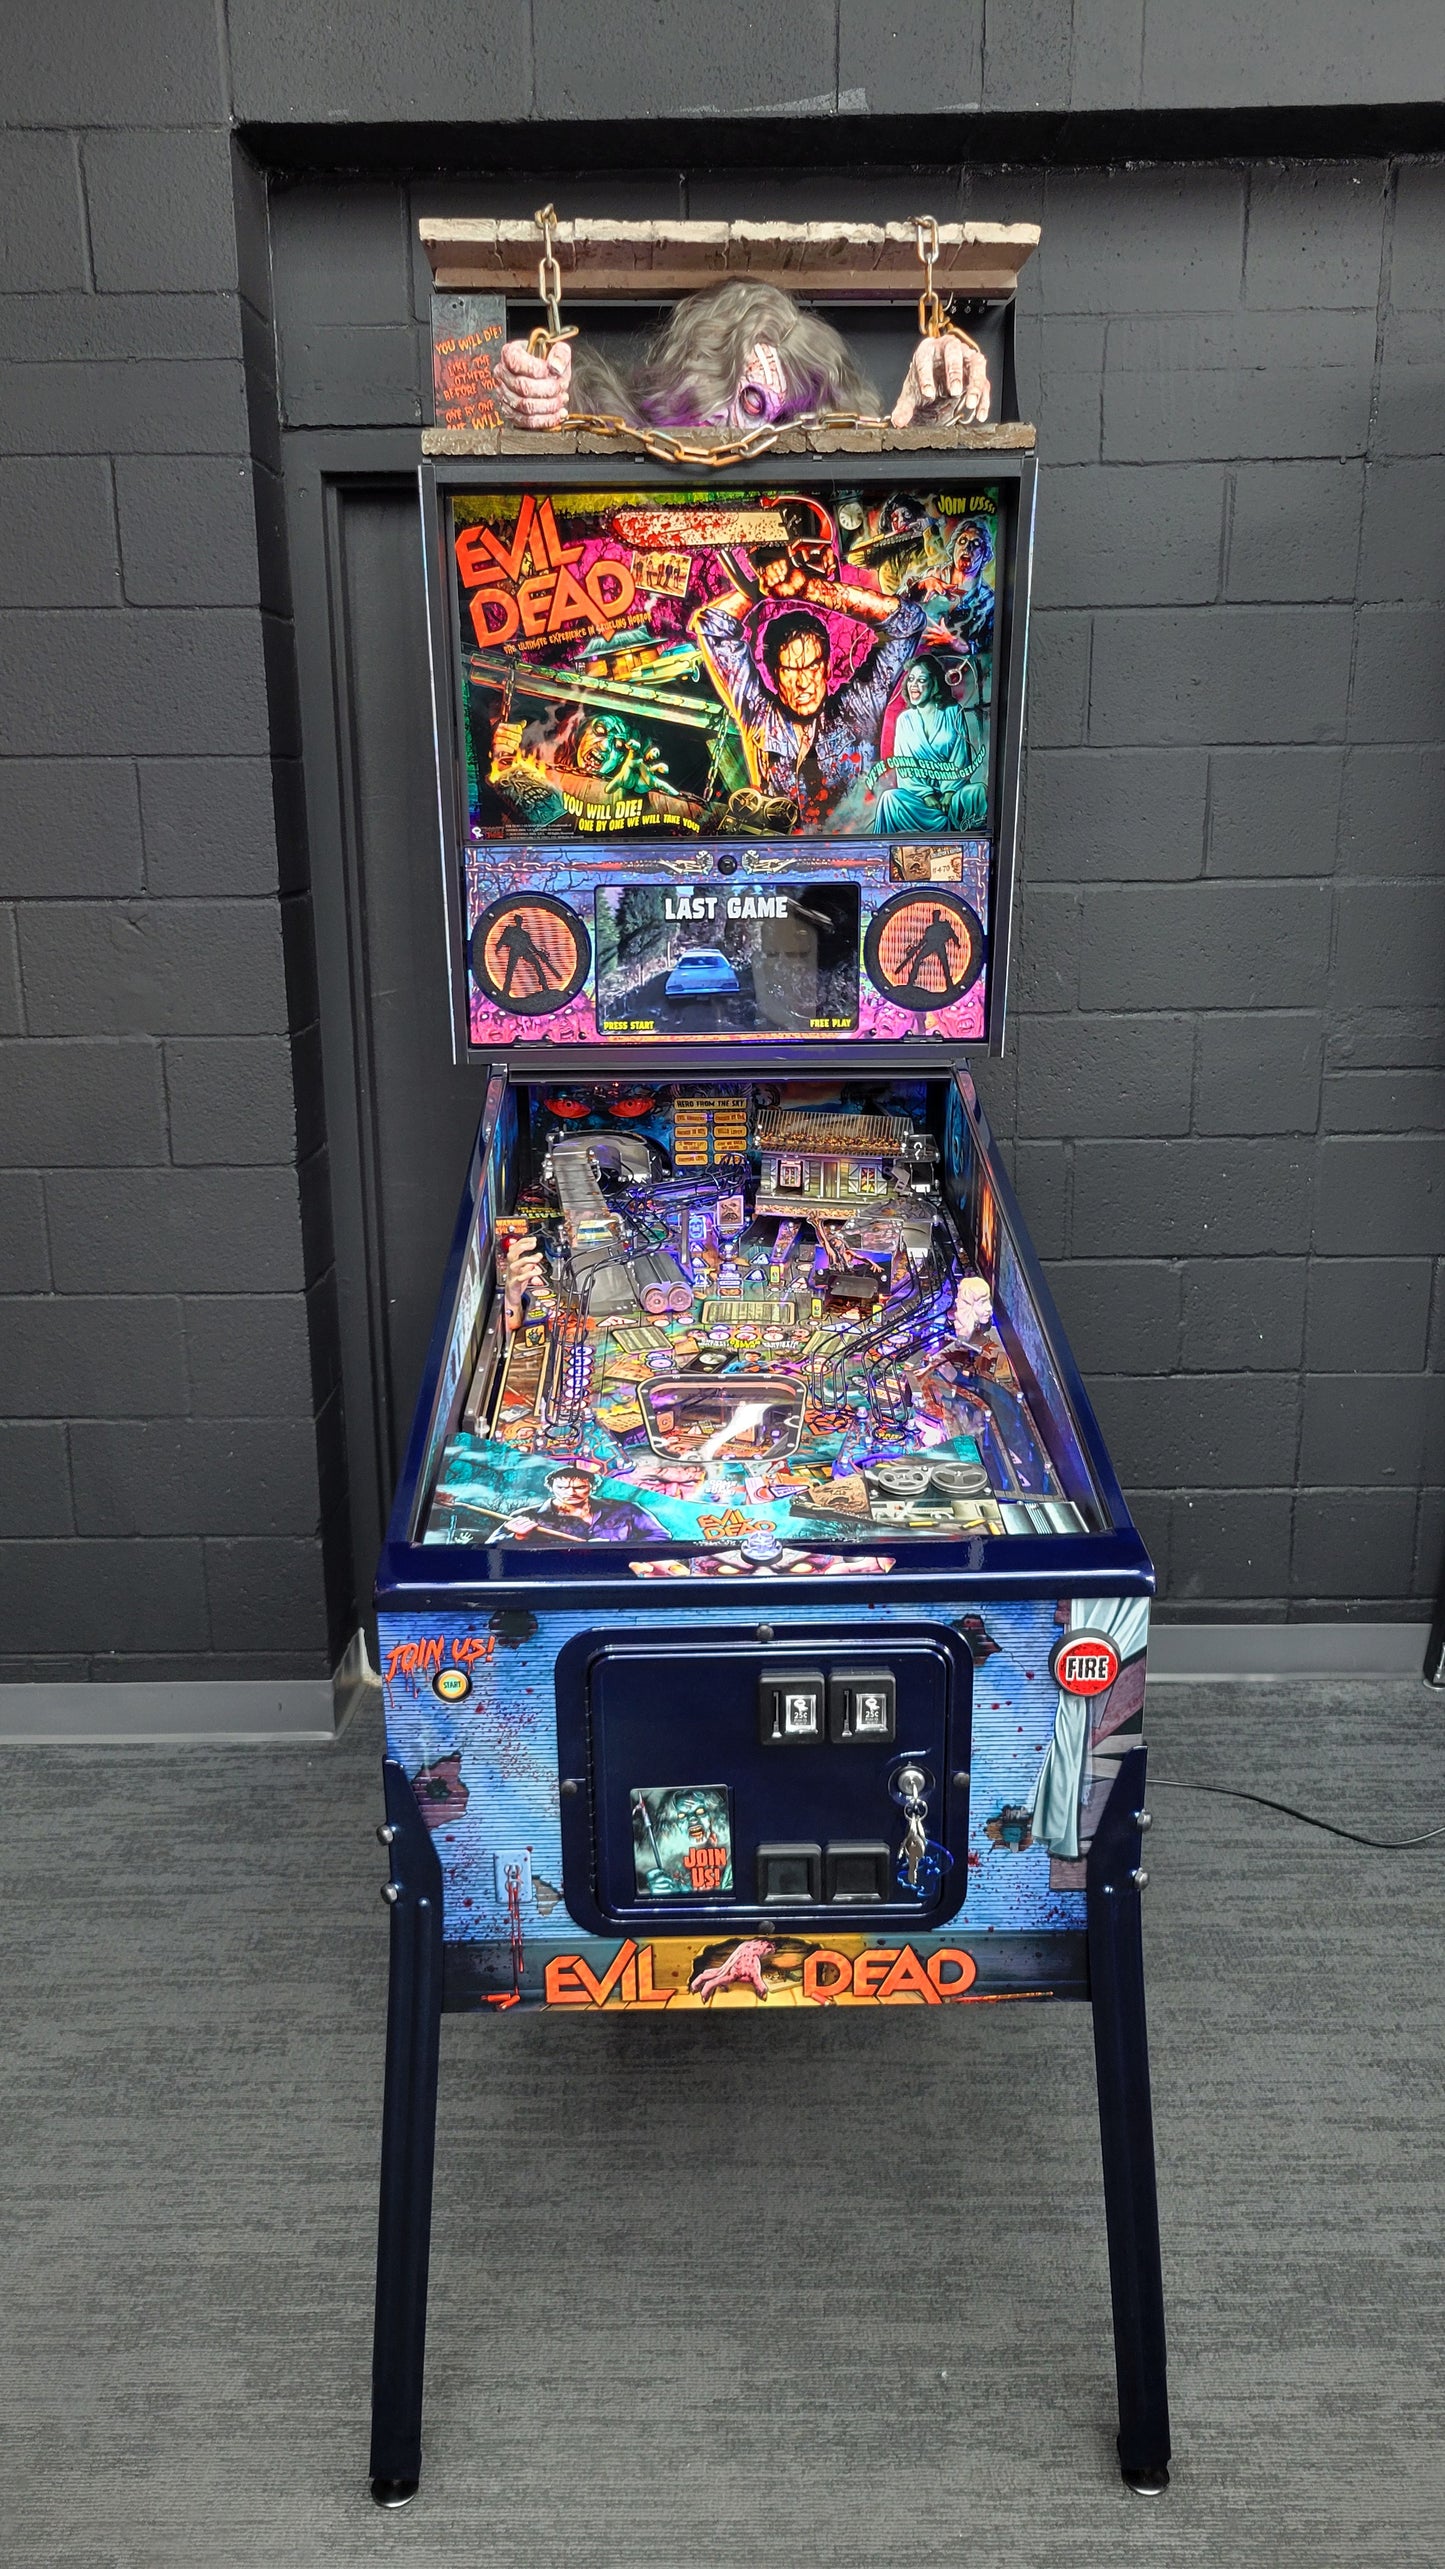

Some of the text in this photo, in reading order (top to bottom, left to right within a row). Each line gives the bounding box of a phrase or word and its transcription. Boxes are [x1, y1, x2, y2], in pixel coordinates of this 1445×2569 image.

[435, 339, 456, 355] YOU
[458, 333, 482, 351] WILL
[447, 354, 490, 377] LIKE THE
[454, 367, 492, 385] OTHERS
[443, 383, 477, 401] BEFORE
[445, 399, 494, 423] ONE BY ONE
[471, 411, 504, 430] WILL
[938, 495, 966, 516] JOIN
[455, 494, 584, 588] EVIL
[469, 561, 636, 649] DEAD
[503, 644, 516, 655] THE
[517, 637, 548, 651] ULTIMATE
[549, 630, 587, 644] EXPERIENCE
[588, 626, 595, 637] IN
[628, 612, 652, 626] HORROR
[887, 757, 917, 769] GONNA
[920, 760, 936, 770] GET
[929, 770, 959, 780] GONNA
[960, 766, 975, 779] GET
[974, 744, 986, 768] YOU
[562, 792, 643, 820] YOU WILL DIE!
[578, 818, 593, 832] ONE
[596, 818, 606, 832] BY
[609, 817, 625, 831] ONE
[627, 816, 640, 828] WE
[642, 813, 660, 826] WILL
[663, 813, 680, 824] TAKE
[682, 817, 700, 833] YOU!
[664, 896, 789, 920] LAST GAME
[603, 1021, 655, 1031] PRESS START
[810, 1019, 851, 1029] FREE PLAY
[697, 1508, 754, 1529] EVIL
[703, 1520, 777, 1541] DEAD
[384, 1634, 496, 1683] JOIN US!
[1066, 1655, 1109, 1680] FIRE
[443, 1680, 461, 1689] START
[684, 1847, 727, 1868] JOIN
[691, 1867, 721, 1888] US!
[544, 1938, 978, 2007] EVIL DEAD
